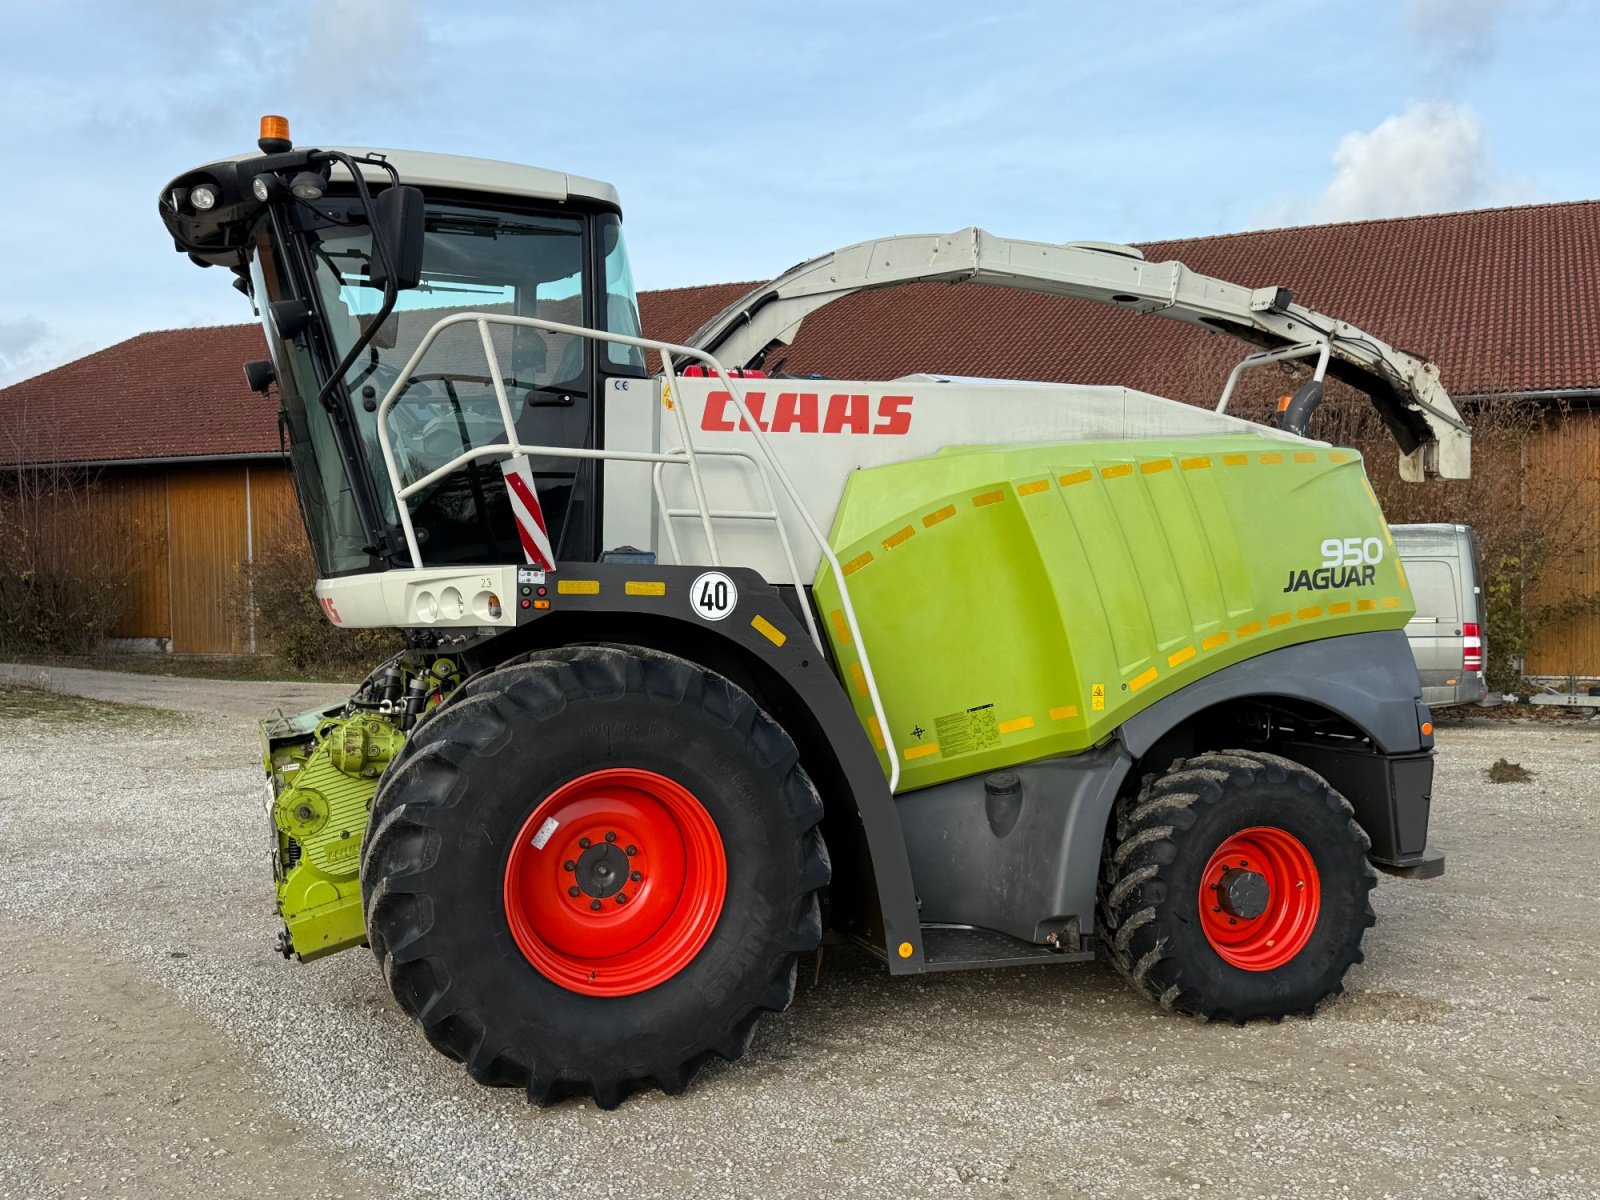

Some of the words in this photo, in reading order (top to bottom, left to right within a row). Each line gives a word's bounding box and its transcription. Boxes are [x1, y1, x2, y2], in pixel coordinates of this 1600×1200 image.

[701, 391, 914, 435] CLAAS
[1321, 537, 1383, 568] 950
[480, 577, 492, 588] 23
[1283, 565, 1376, 593] JAGUAR
[700, 581, 727, 610] 40
